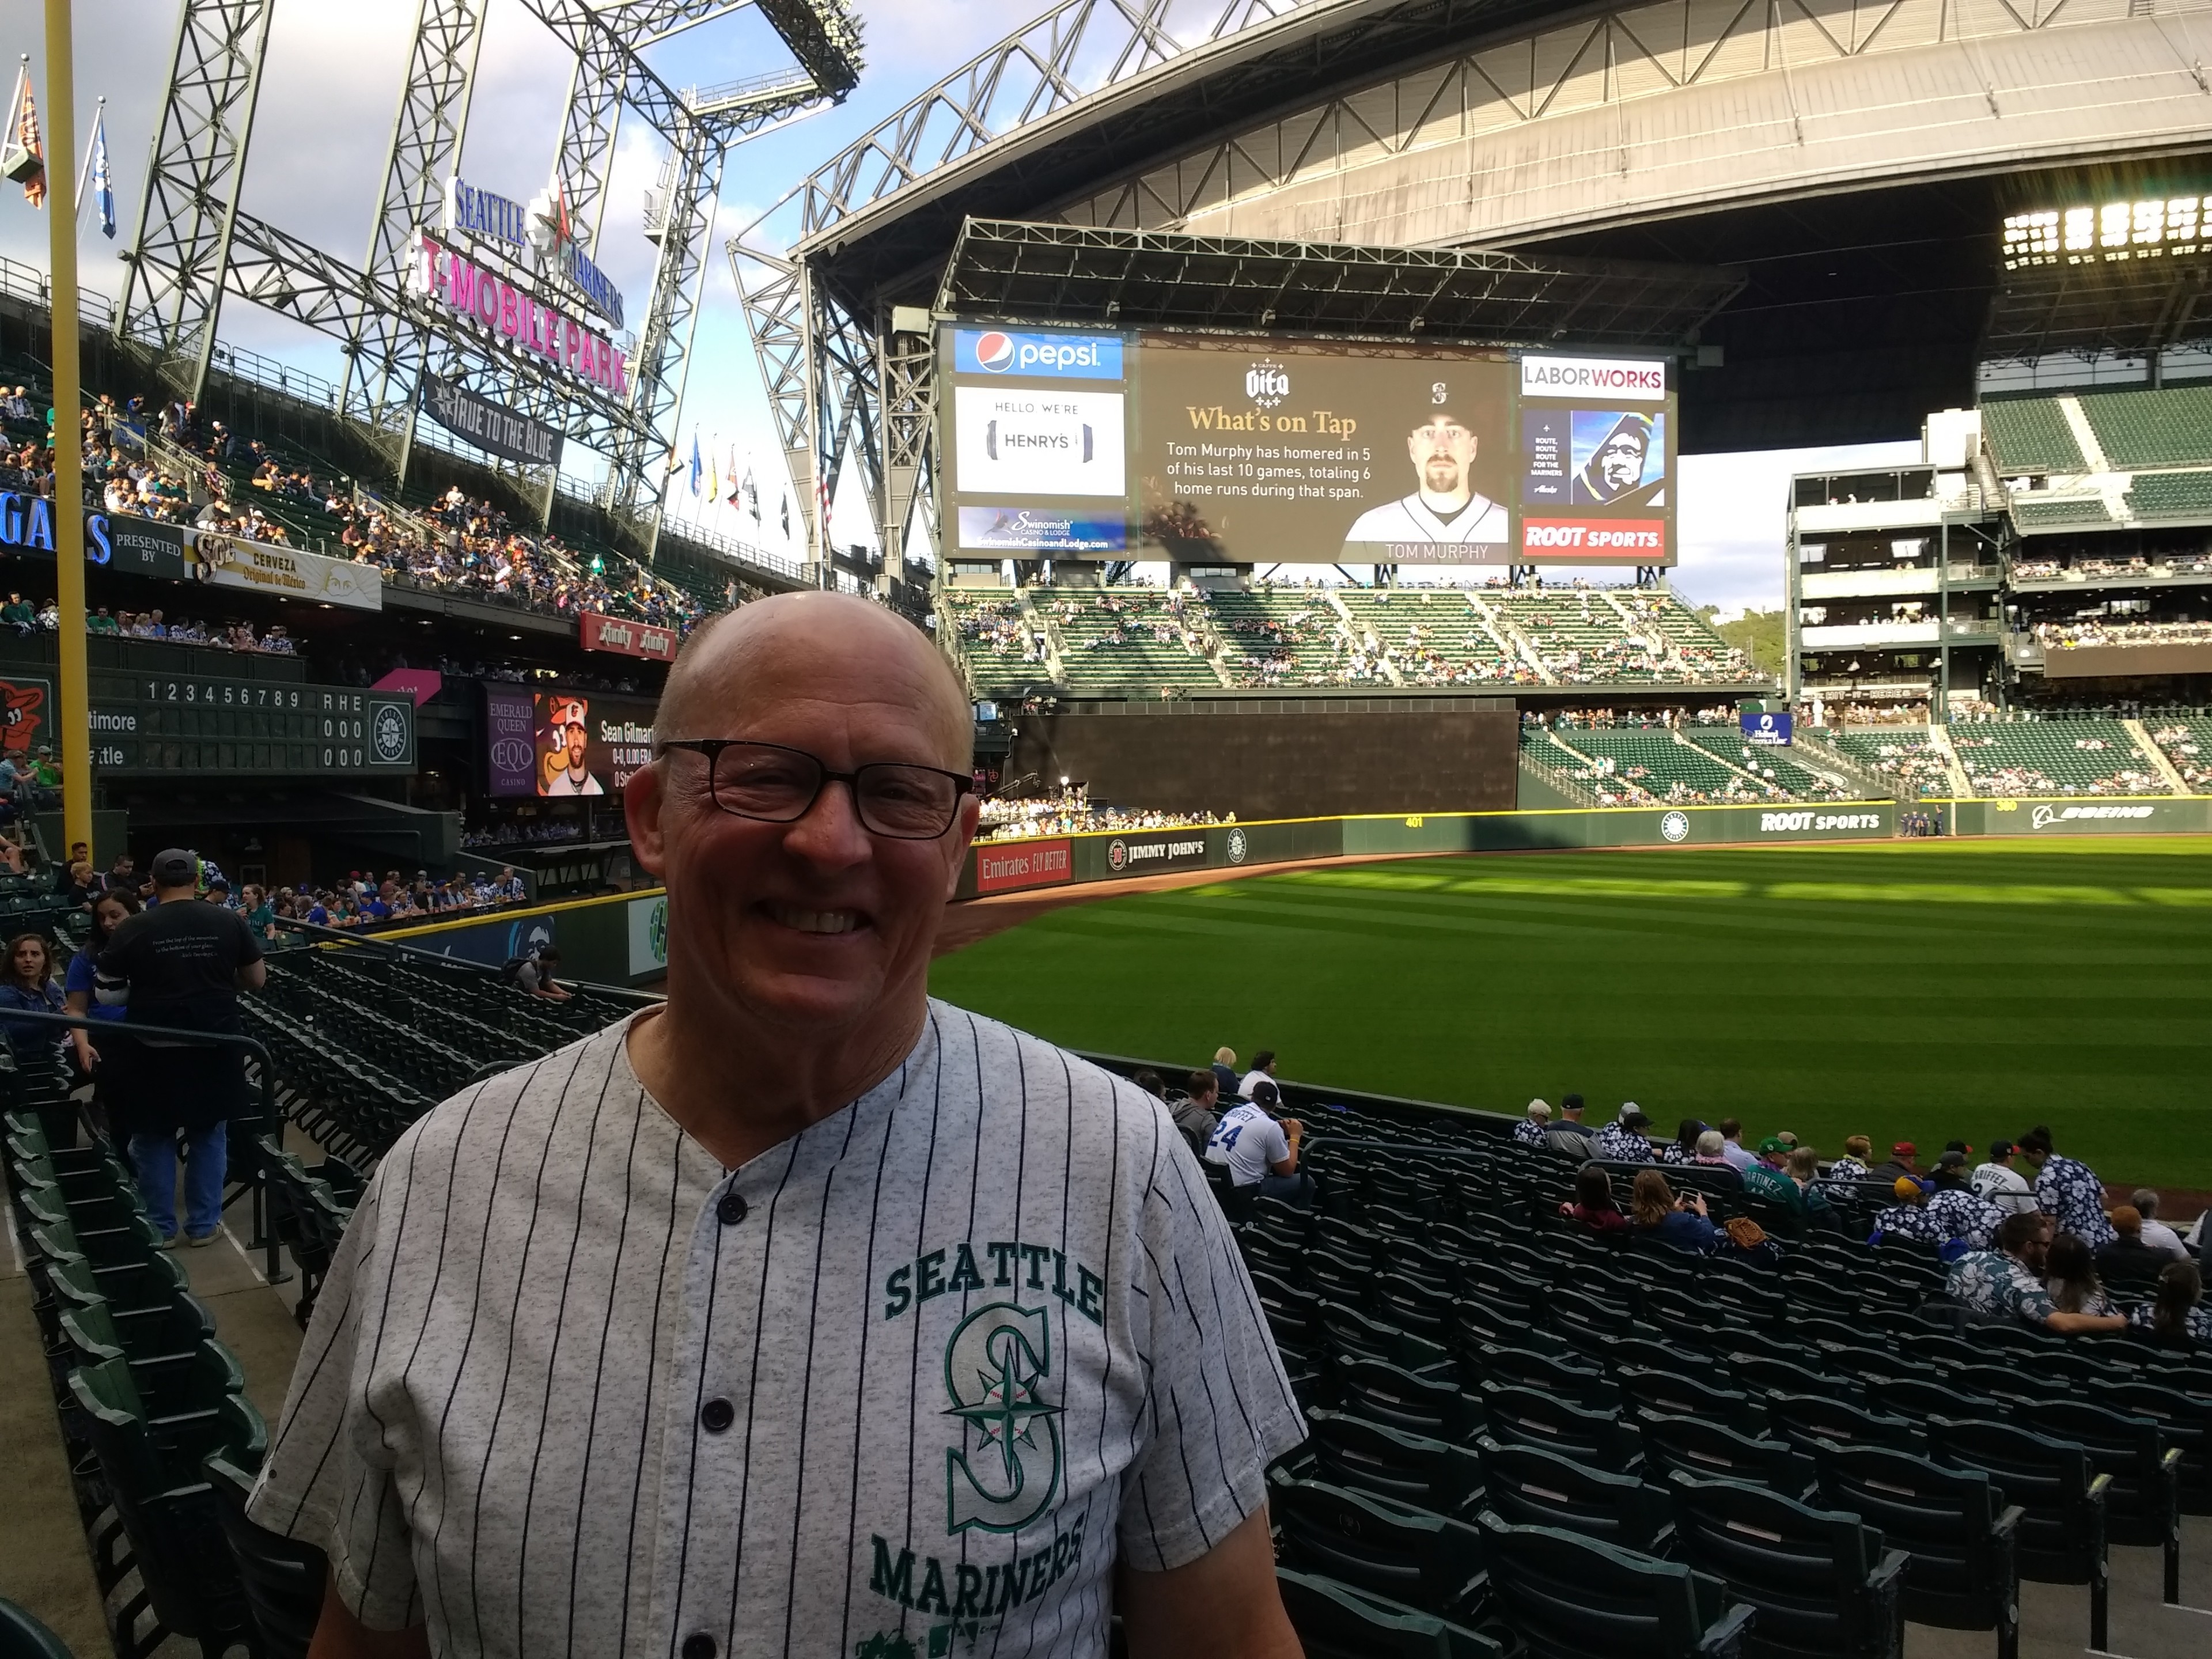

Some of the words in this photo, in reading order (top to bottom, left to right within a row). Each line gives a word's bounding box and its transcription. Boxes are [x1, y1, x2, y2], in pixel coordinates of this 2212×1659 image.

[454, 179, 525, 247] SEATTLE
[422, 235, 559, 360] T-MOBILE
[567, 321, 627, 396] PARK
[1020, 342, 1097, 371] pepsi
[1246, 369, 1290, 398] Vita
[1524, 366, 1662, 389] LABORWORKS
[1041, 404, 1079, 414] WE'RE
[453, 386, 485, 436] TRUE
[486, 408, 502, 442] TO
[503, 415, 525, 452] THE
[525, 419, 554, 462] BLUE
[1186, 406, 1271, 431] What's
[1277, 416, 1308, 433] on
[1312, 410, 1357, 441] Tap
[1005, 433, 1069, 449] HENRY'S
[1166, 442, 1197, 457] Tom
[1201, 443, 1253, 460] Murphy
[1256, 445, 1280, 459] has
[1284, 446, 1343, 460] homered
[1347, 448, 1359, 460] in
[1362, 448, 1371, 461] 5
[1166, 462, 1181, 475] of
[1184, 462, 1205, 476] his
[1209, 463, 1233, 477] last
[1238, 464, 1253, 477] 10
[1257, 467, 1305, 480] games,
[1309, 466, 1359, 483] totaling
[1363, 467, 1371, 480] 6
[1175, 482, 1213, 495] home
[1217, 484, 1248, 496] runs
[1252, 483, 1295, 499] during
[1298, 484, 1325, 498] that
[1328, 487, 1364, 501] span.
[1012, 511, 1071, 531] Swinomish
[116, 534, 181, 557] PRESENTED
[1525, 526, 1587, 547] ROOT
[1586, 531, 1659, 548] SPORTS
[142, 549, 156, 563] BY
[1385, 543, 1418, 559] TOM
[1423, 544, 1488, 559] MURPHY
[253, 553, 297, 573] CERVEZA
[243, 566, 274, 584] Original
[149, 681, 155, 699] 1
[168, 683, 177, 700] 2
[186, 684, 195, 702] 3
[205, 686, 214, 702] 4
[224, 687, 232, 703] 5
[241, 688, 249, 704] 6
[258, 690, 266, 705] 7
[274, 691, 282, 706] 8
[290, 692, 298, 707] 9
[324, 694, 332, 710] R
[339, 695, 347, 711] H
[353, 696, 361, 711] E
[490, 703, 533, 719] EMERALD
[324, 719, 332, 737] 0
[339, 721, 347, 738] 0
[353, 721, 361, 738] 0
[497, 718, 527, 734] QUEEN
[601, 719, 623, 743] Sean
[324, 749, 332, 766] 0
[339, 749, 347, 766] 0
[354, 749, 362, 766] 0
[613, 748, 626, 767] 0-0,
[626, 748, 639, 764] 0.00
[640, 748, 652, 764] ERA
[615, 771, 620, 787] 0
[1406, 816, 1423, 828] 401
[1761, 812, 1815, 831] ROOT
[1815, 814, 1880, 830] SPORTS
[2061, 806, 2155, 819] BOEING
[1113, 847, 1123, 863] JJ
[1128, 844, 1166, 863] JIMMY
[1168, 841, 1205, 860] JOHN'S
[982, 855, 1029, 879] Emirates
[1033, 852, 1044, 873] FLY
[1045, 850, 1067, 871] BETTER
[1208, 1121, 1244, 1153] 24
[885, 1240, 1104, 1327] SEATTLE
[945, 1301, 1061, 1536] S
[868, 1511, 1085, 1619] MARINERS
